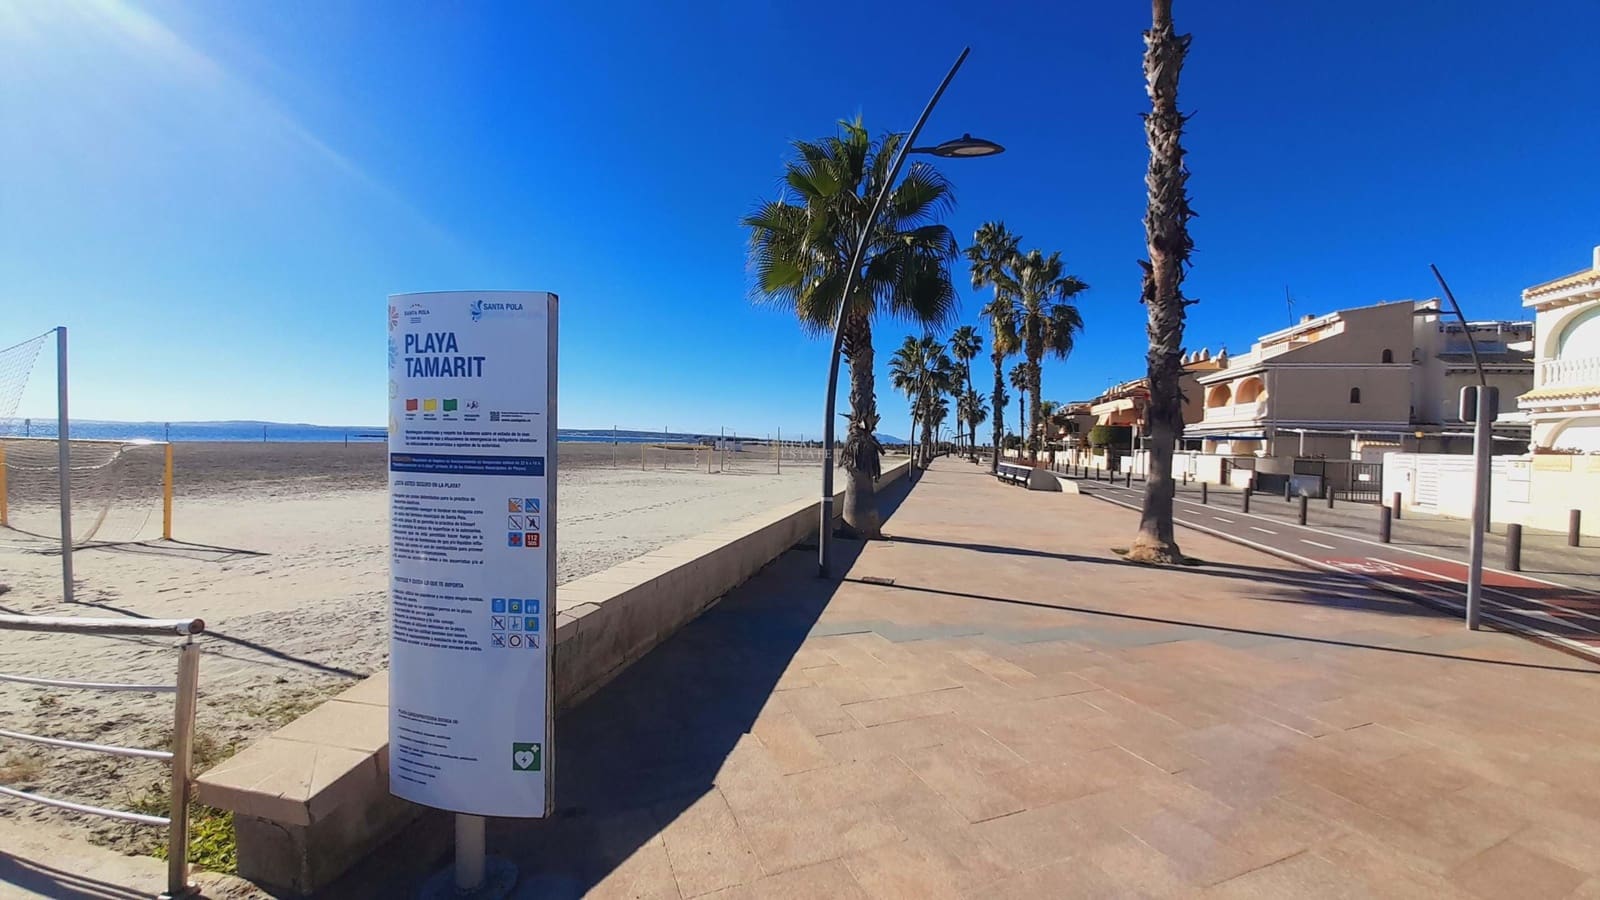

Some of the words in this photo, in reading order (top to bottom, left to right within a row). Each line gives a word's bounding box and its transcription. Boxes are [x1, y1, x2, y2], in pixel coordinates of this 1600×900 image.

[483, 303, 504, 311] SANTA
[505, 303, 523, 311] POLA
[405, 332, 459, 354] PLAYA
[405, 356, 486, 378] TAMARIT
[527, 534, 538, 542] 112
